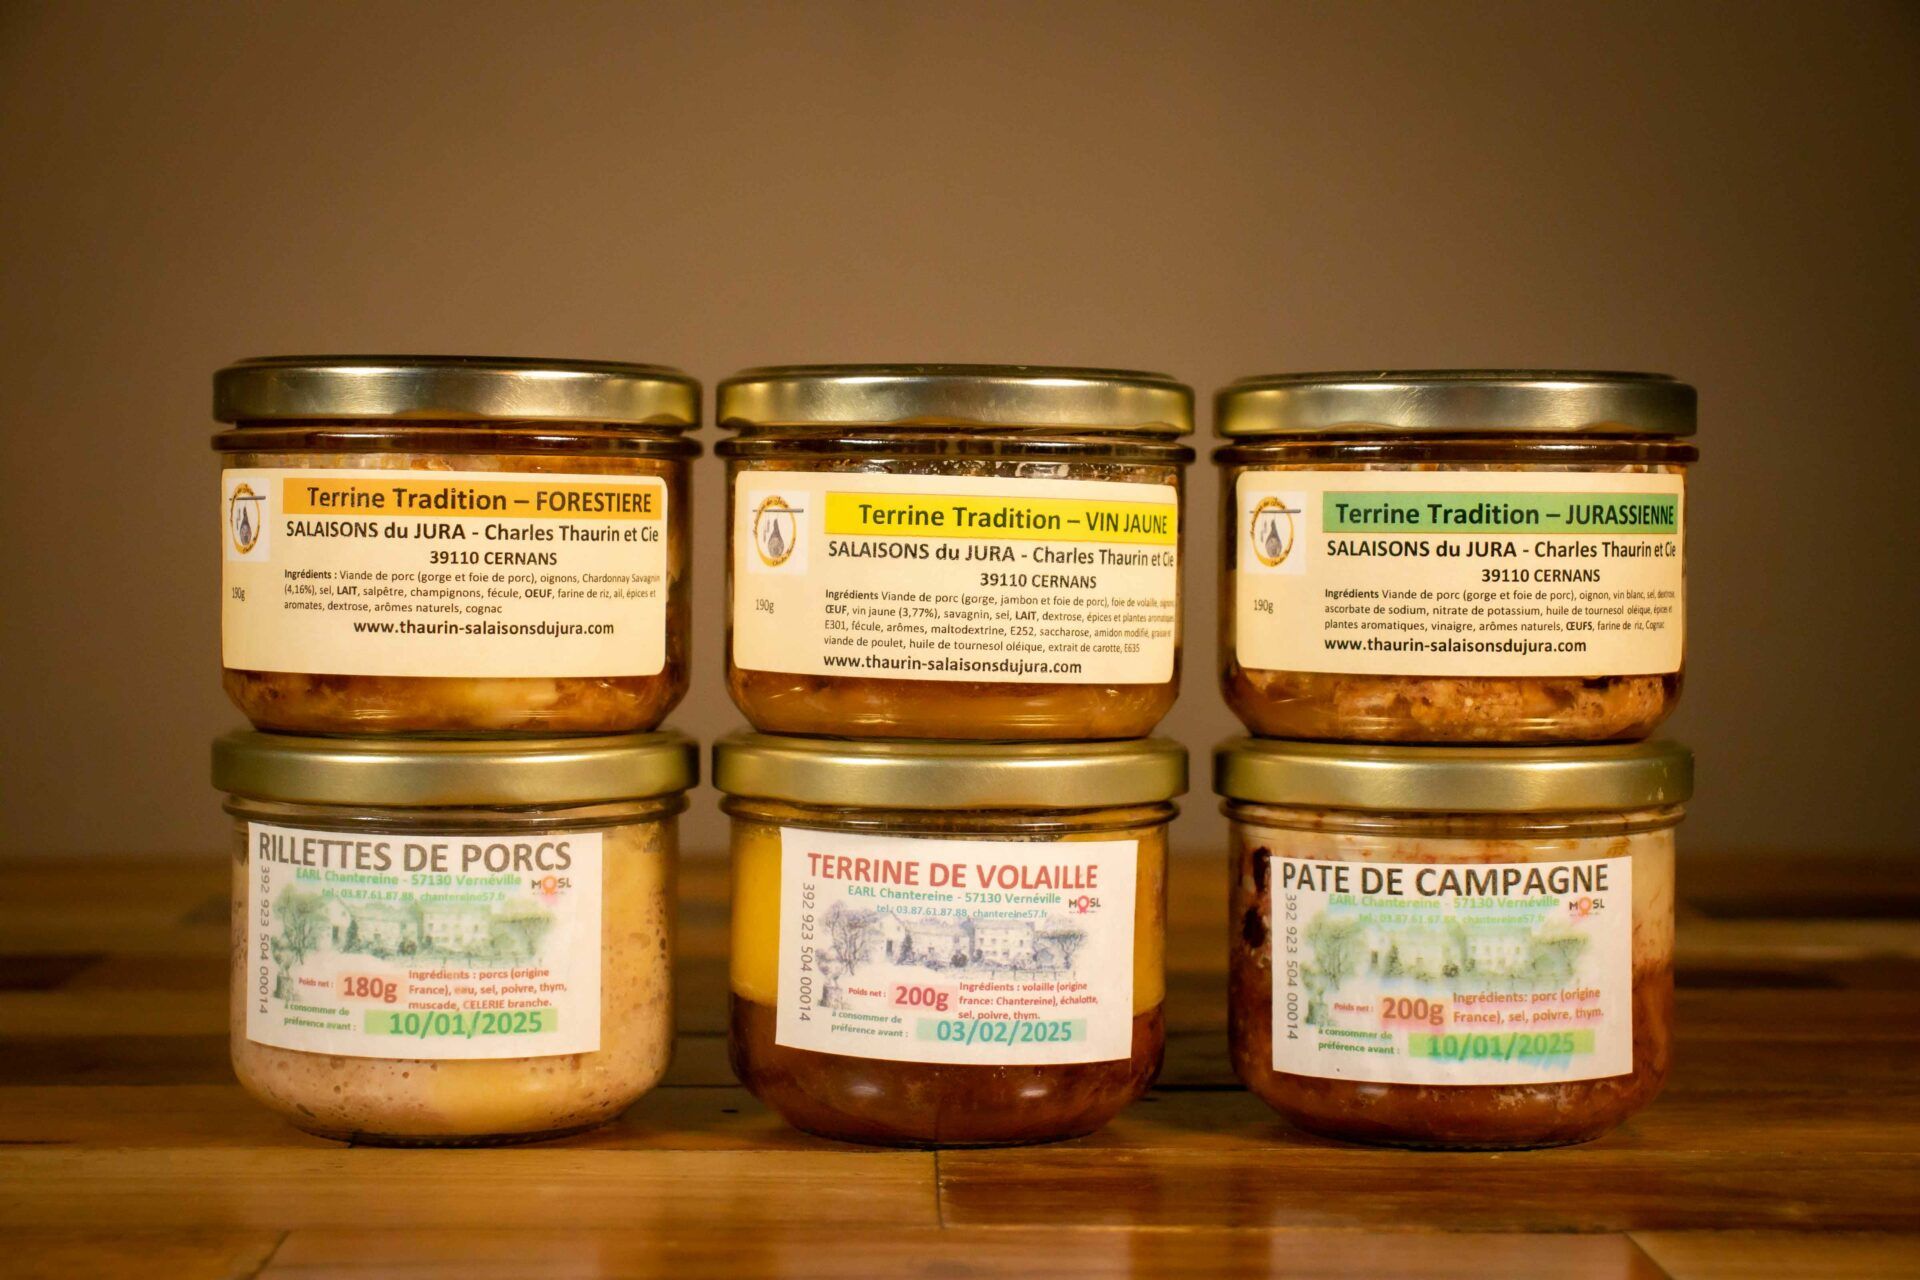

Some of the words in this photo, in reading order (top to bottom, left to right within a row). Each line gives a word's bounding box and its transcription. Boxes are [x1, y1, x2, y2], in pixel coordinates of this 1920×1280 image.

[307, 487, 385, 508] Terrine
[393, 487, 506, 510] Tradition
[536, 491, 651, 512] FORESTIERE
[859, 504, 944, 526] Terrine
[952, 507, 1060, 530] Tradition
[1086, 512, 1118, 532] VIN
[1124, 514, 1167, 534] JAUNE
[1336, 503, 1419, 524] Terrine
[1427, 503, 1539, 524] Tradition
[1566, 504, 1674, 525] JURASSIENNE
[286, 521, 378, 538] SALAISONS
[384, 524, 408, 538] du
[414, 523, 465, 539] JURA
[485, 524, 553, 541] Charles
[559, 526, 619, 541] Thaurin
[625, 528, 637, 541] et
[642, 526, 659, 542] Cie
[829, 540, 929, 559] SALAISONS
[936, 544, 959, 560] du
[965, 545, 1015, 561] JURA
[1033, 546, 1094, 564] Charles
[1099, 549, 1147, 566] Thaurin
[1152, 552, 1160, 566] et
[1327, 540, 1429, 557] SALAISONS
[1436, 541, 1460, 557] du
[1466, 541, 1517, 557] JURA
[1535, 541, 1597, 557] Charles
[1602, 541, 1651, 557] Thaurin
[1654, 544, 1662, 557] et
[430, 551, 479, 564] 39110
[484, 552, 557, 565] CERNANS
[285, 569, 331, 580] Ingrédients
[340, 571, 372, 580] Viande
[375, 571, 388, 580] de
[392, 573, 414, 584] porc
[418, 572, 451, 584] (gorge
[455, 574, 466, 582] et
[469, 572, 488, 582] foie
[492, 573, 504, 583] de
[508, 574, 537, 585] porc),
[540, 574, 579, 584] oignons,
[980, 573, 1027, 587] 39110
[1032, 575, 1096, 589] CERNANS
[1482, 569, 1529, 582] 39110
[1534, 569, 1600, 582] CERNANS
[285, 585, 317, 595] (4,16%),
[320, 586, 334, 595] sel,
[337, 587, 360, 596] LAIT,
[363, 588, 407, 598] salpêtre,
[411, 588, 484, 598] champignons,
[487, 589, 522, 598] fécule,
[525, 589, 554, 599] OEUF,
[558, 589, 584, 598] farine
[825, 589, 878, 600] Ingrédients
[881, 591, 915, 601] Viande
[919, 592, 931, 601] de
[935, 594, 958, 604] porc
[1325, 589, 1379, 599] Ingrédients
[1382, 590, 1417, 599] Viande
[1420, 590, 1433, 599] de
[1436, 592, 1459, 600] porc
[756, 599, 774, 613] 190g
[852, 606, 865, 615] vin
[868, 607, 895, 617] jaune
[1254, 600, 1273, 614] 190g
[1325, 605, 1370, 614] ascorbate
[1373, 605, 1386, 614] de
[1389, 605, 1429, 616] sodium,
[354, 620, 614, 637] www.thaurin-salaisonsdujura.com
[1325, 638, 1586, 655] www.thaurin-salaisonsdujura.com
[824, 654, 1082, 675] www.thaurin-salaisonsdujura.com
[260, 832, 391, 871] RILLETTES
[404, 844, 448, 872] DE
[462, 842, 571, 872] PORCS
[260, 865, 270, 893] 392
[325, 870, 398, 885] Chantereine
[411, 875, 452, 885] 57130
[456, 875, 521, 886] Vernéville
[808, 853, 919, 886] TERRINE
[930, 863, 966, 888] DE
[977, 864, 1097, 889] VOLAILLE
[1283, 862, 1349, 893] PATE
[1362, 868, 1403, 895] DE
[1416, 864, 1608, 896] CAMPAGNE
[802, 883, 814, 909] 392
[848, 886, 875, 897] EARL
[880, 888, 953, 902] Chantereine
[965, 893, 1000, 903] 57130
[1005, 893, 1061, 904] Vernéville
[1454, 898, 1493, 908] 57130
[1498, 896, 1560, 908] Vernéville
[260, 900, 270, 927] 923
[1286, 894, 1297, 920] 392
[801, 915, 813, 940] 923
[1286, 927, 1297, 954] 923
[409, 970, 469, 981] Ingrédients
[479, 971, 508, 981] porcs
[511, 969, 549, 980] (origine
[260, 966, 268, 1014] 00014
[344, 977, 397, 1003] 180g
[409, 985, 451, 996] France),
[480, 985, 498, 995] sel,
[501, 984, 537, 997] poivre,
[540, 982, 567, 993] thym,
[849, 988, 868, 996] Poids
[960, 982, 1014, 992] Ingrédients
[1023, 983, 1054, 991] volaille
[1057, 982, 1087, 992] (origine
[409, 1002, 460, 1011] muscade,
[463, 1000, 504, 1009] CELERIE
[508, 999, 552, 1008] branche.
[799, 977, 811, 1021] 00014
[896, 986, 948, 1011] 200g
[996, 997, 1058, 1007] Chantereine),
[1453, 991, 1527, 1005] Ingrédients:
[1532, 992, 1557, 1003] porc
[1561, 988, 1600, 1000] (origine
[839, 1011, 888, 1023] consommer
[959, 1011, 974, 1020] sel,
[978, 1011, 1011, 1020] poivre,
[1014, 1011, 1040, 1020] thym.
[1287, 993, 1298, 1039] 00014
[1382, 997, 1443, 1025] 200g
[1453, 1011, 1504, 1023] France),
[1509, 1012, 1529, 1023] sel,
[1533, 1010, 1572, 1022] poivre,
[1576, 1008, 1603, 1019] thym.
[831, 1024, 876, 1035] préférence
[937, 1020, 1072, 1045] 03/02/2025
[1428, 1032, 1575, 1060] 10/01/2025
